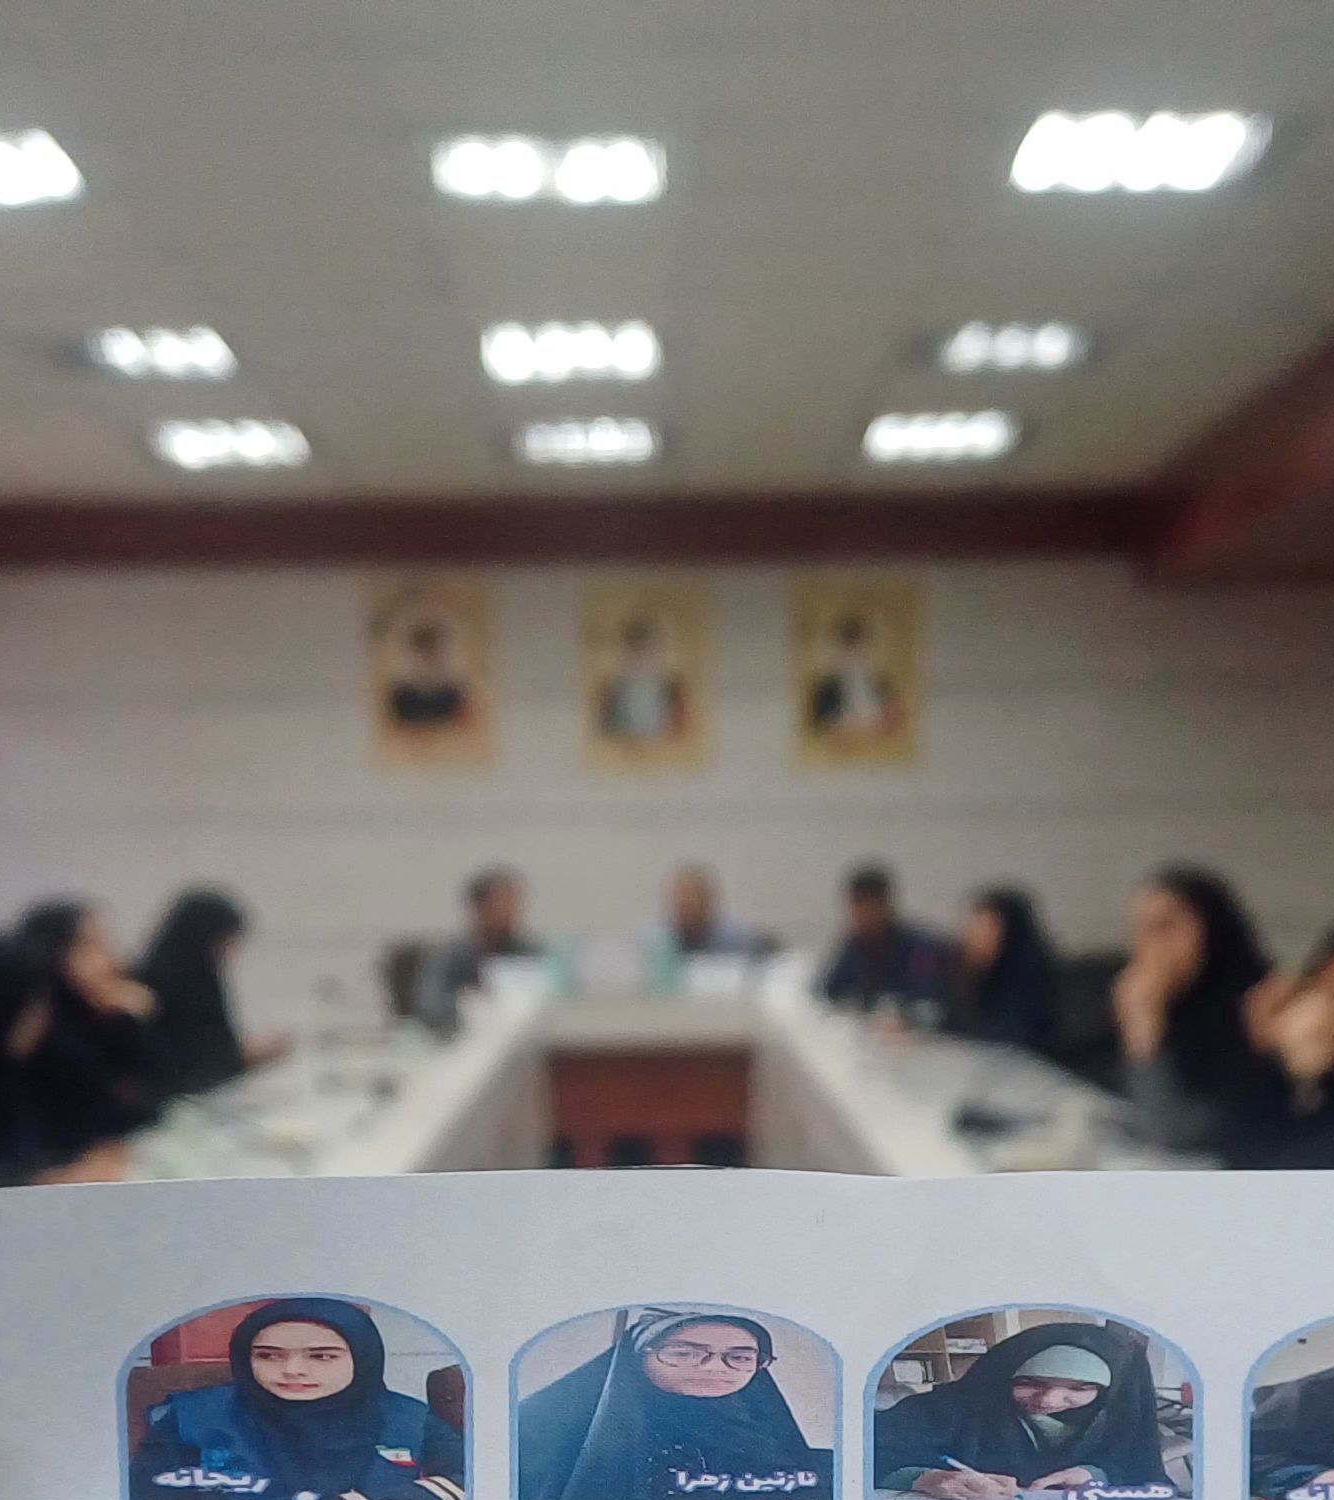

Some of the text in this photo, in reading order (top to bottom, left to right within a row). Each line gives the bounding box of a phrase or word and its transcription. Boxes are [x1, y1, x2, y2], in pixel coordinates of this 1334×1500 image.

[152, 1467, 272, 1493] ریحانه
[676, 1470, 818, 1494] نازنین زهرا
